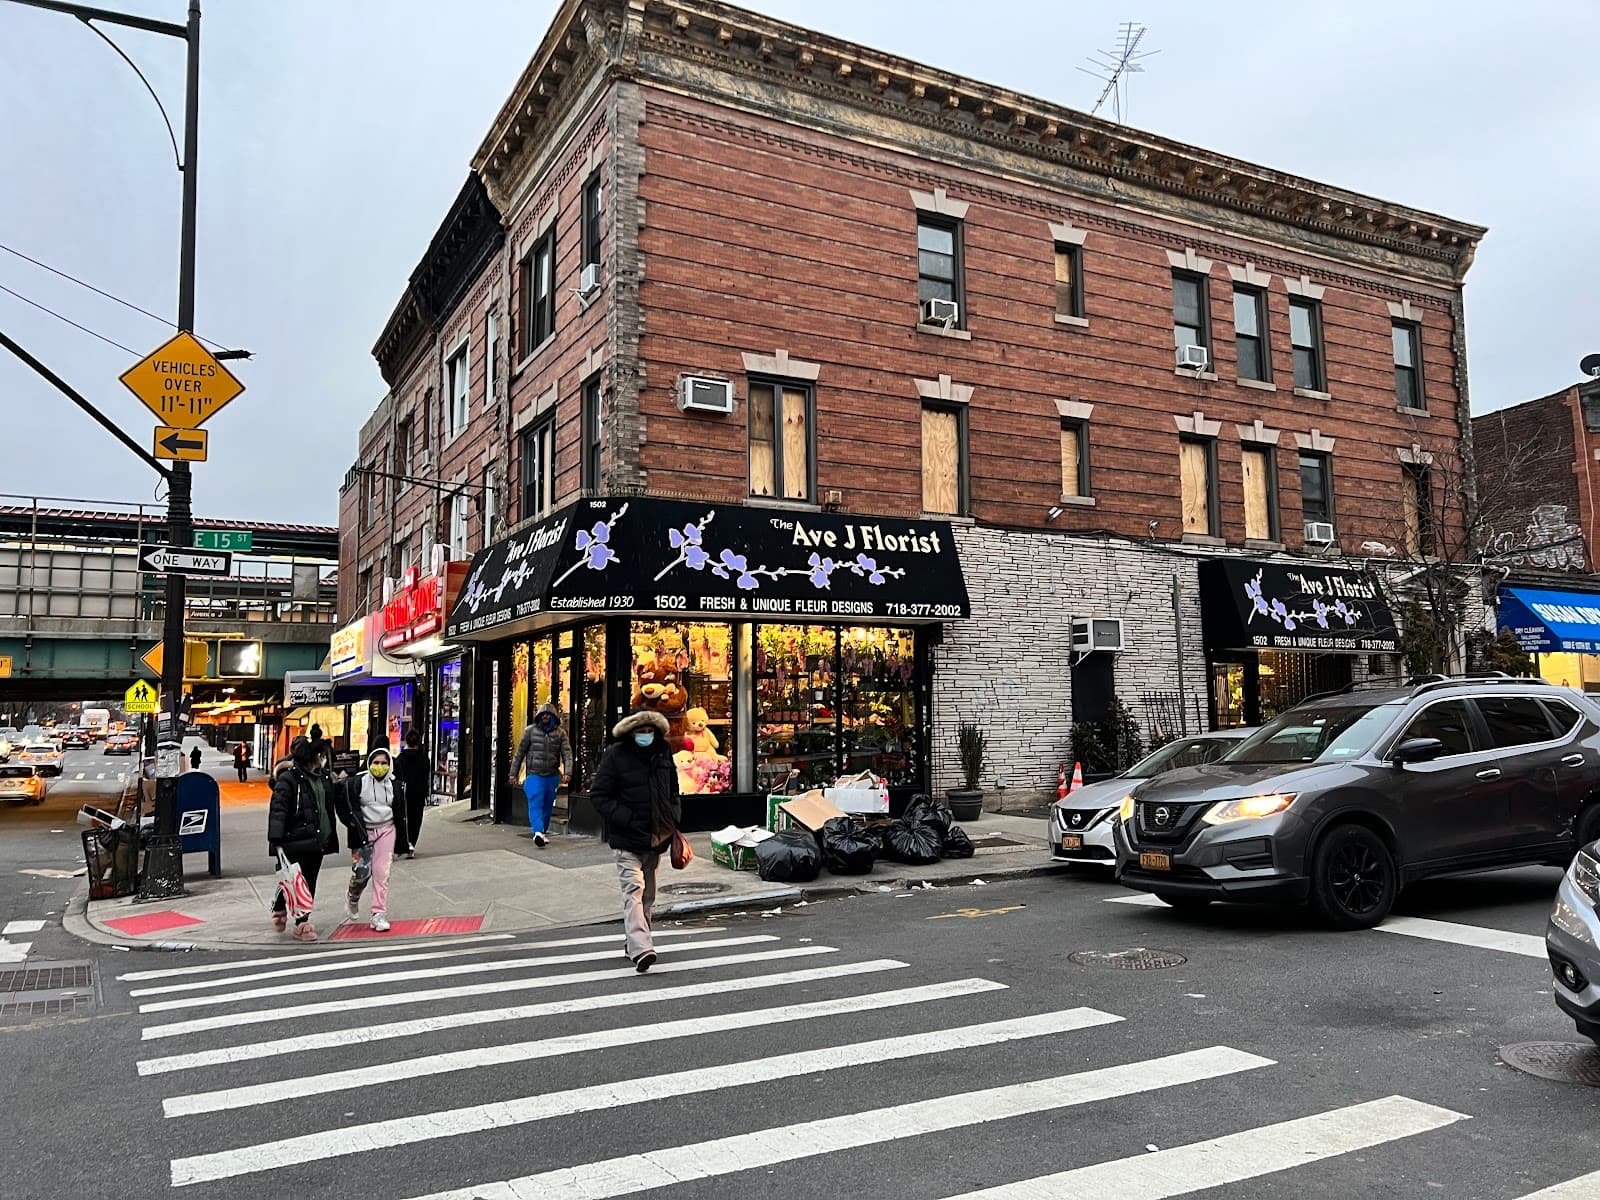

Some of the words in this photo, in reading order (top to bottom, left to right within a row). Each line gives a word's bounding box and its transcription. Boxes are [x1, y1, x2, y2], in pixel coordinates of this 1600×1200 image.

[152, 360, 216, 377] VEHICLES
[164, 378, 202, 393] OVER
[195, 532, 204, 547] E
[213, 533, 231, 548] 15
[236, 534, 248, 543] ST
[505, 542, 525, 564] Ave
[528, 517, 567, 554] Florist
[770, 518, 794, 530] The
[792, 521, 838, 548] Ave
[843, 524, 856, 549] J
[859, 524, 941, 553] Florist
[153, 554, 180, 566] ONE
[192, 557, 219, 568] WAY
[1300, 573, 1324, 595] Ave
[1324, 575, 1334, 596] J
[1332, 575, 1377, 599] Florist
[550, 596, 606, 608] Established
[608, 596, 634, 608] 1930
[653, 595, 687, 609] 1502
[700, 596, 736, 610] FRESH
[740, 597, 748, 610] &
[752, 598, 791, 612] UNIQUE
[795, 599, 828, 613] FLEUR
[831, 600, 874, 614] DESIGNS
[885, 602, 961, 617] 718-377-2002
[217, 610, 223, 618] J
[1531, 602, 1588, 624] SUSAN
[1252, 635, 1268, 646] 1502
[1274, 636, 1292, 647] FRESH
[1297, 636, 1317, 648] UNIQUE
[1317, 637, 1334, 648] FLEUR
[1335, 638, 1356, 649] DESIGNS
[1361, 639, 1396, 650] 718-377-2002
[127, 702, 152, 710] SCHOOL
